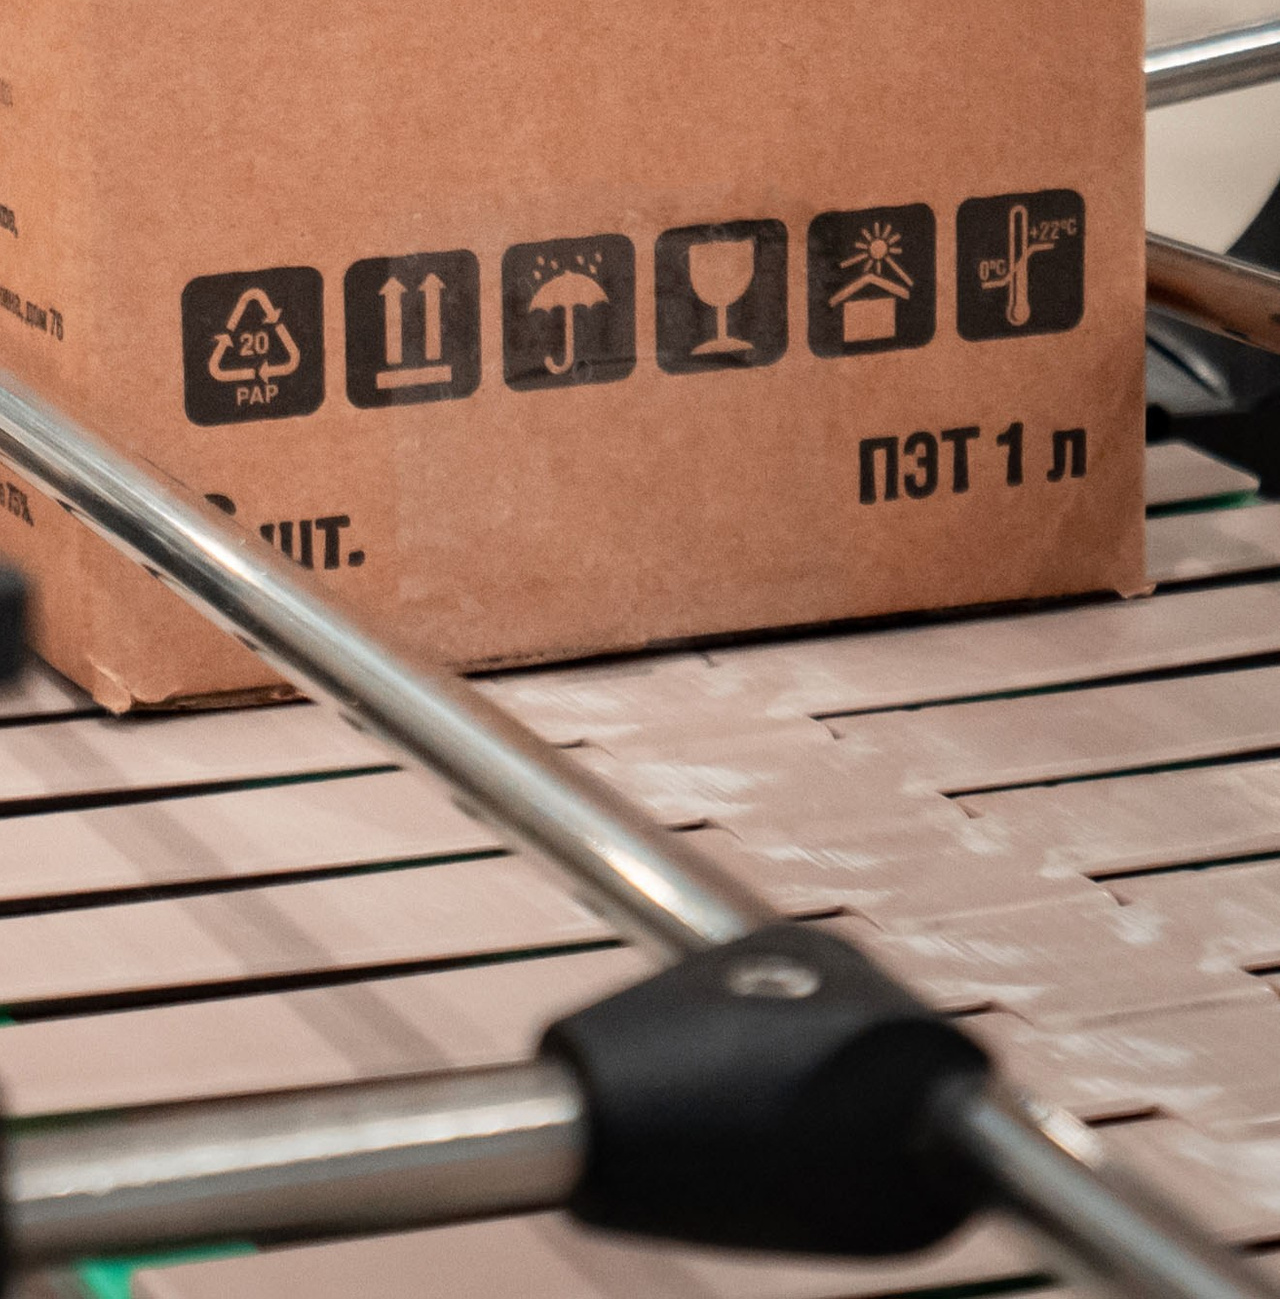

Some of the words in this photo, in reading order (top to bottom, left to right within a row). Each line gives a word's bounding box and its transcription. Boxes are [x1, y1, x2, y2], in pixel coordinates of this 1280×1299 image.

[239, 332, 269, 356] 20
[236, 384, 279, 406] PAP
[859, 426, 980, 505] ПЭТ
[996, 421, 1024, 487] 1
[1047, 428, 1087, 482] л
